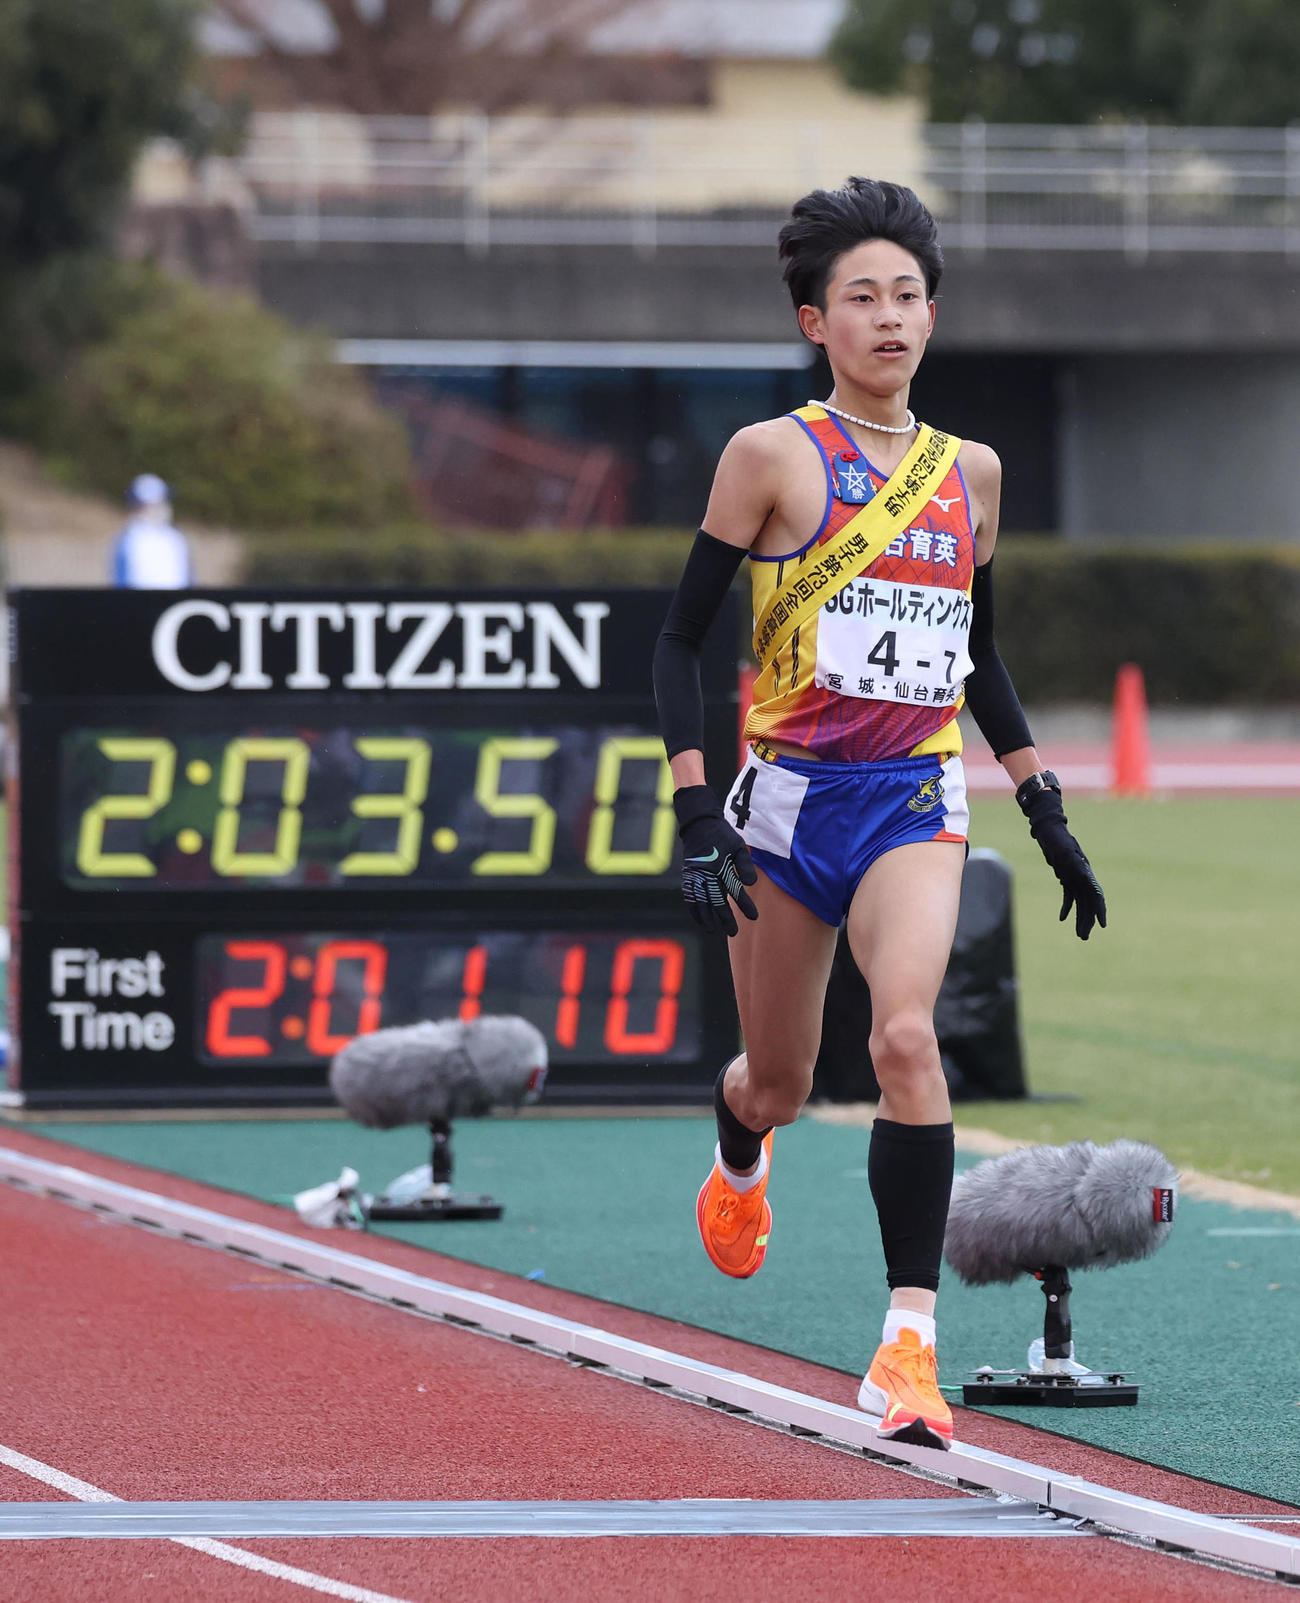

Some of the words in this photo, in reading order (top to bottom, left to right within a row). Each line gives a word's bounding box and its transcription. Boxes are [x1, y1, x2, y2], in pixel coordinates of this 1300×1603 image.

[152, 600, 610, 690] CITIZEN
[730, 767, 757, 830] 4
[50, 949, 165, 997] First
[49, 1002, 175, 1050] Time
